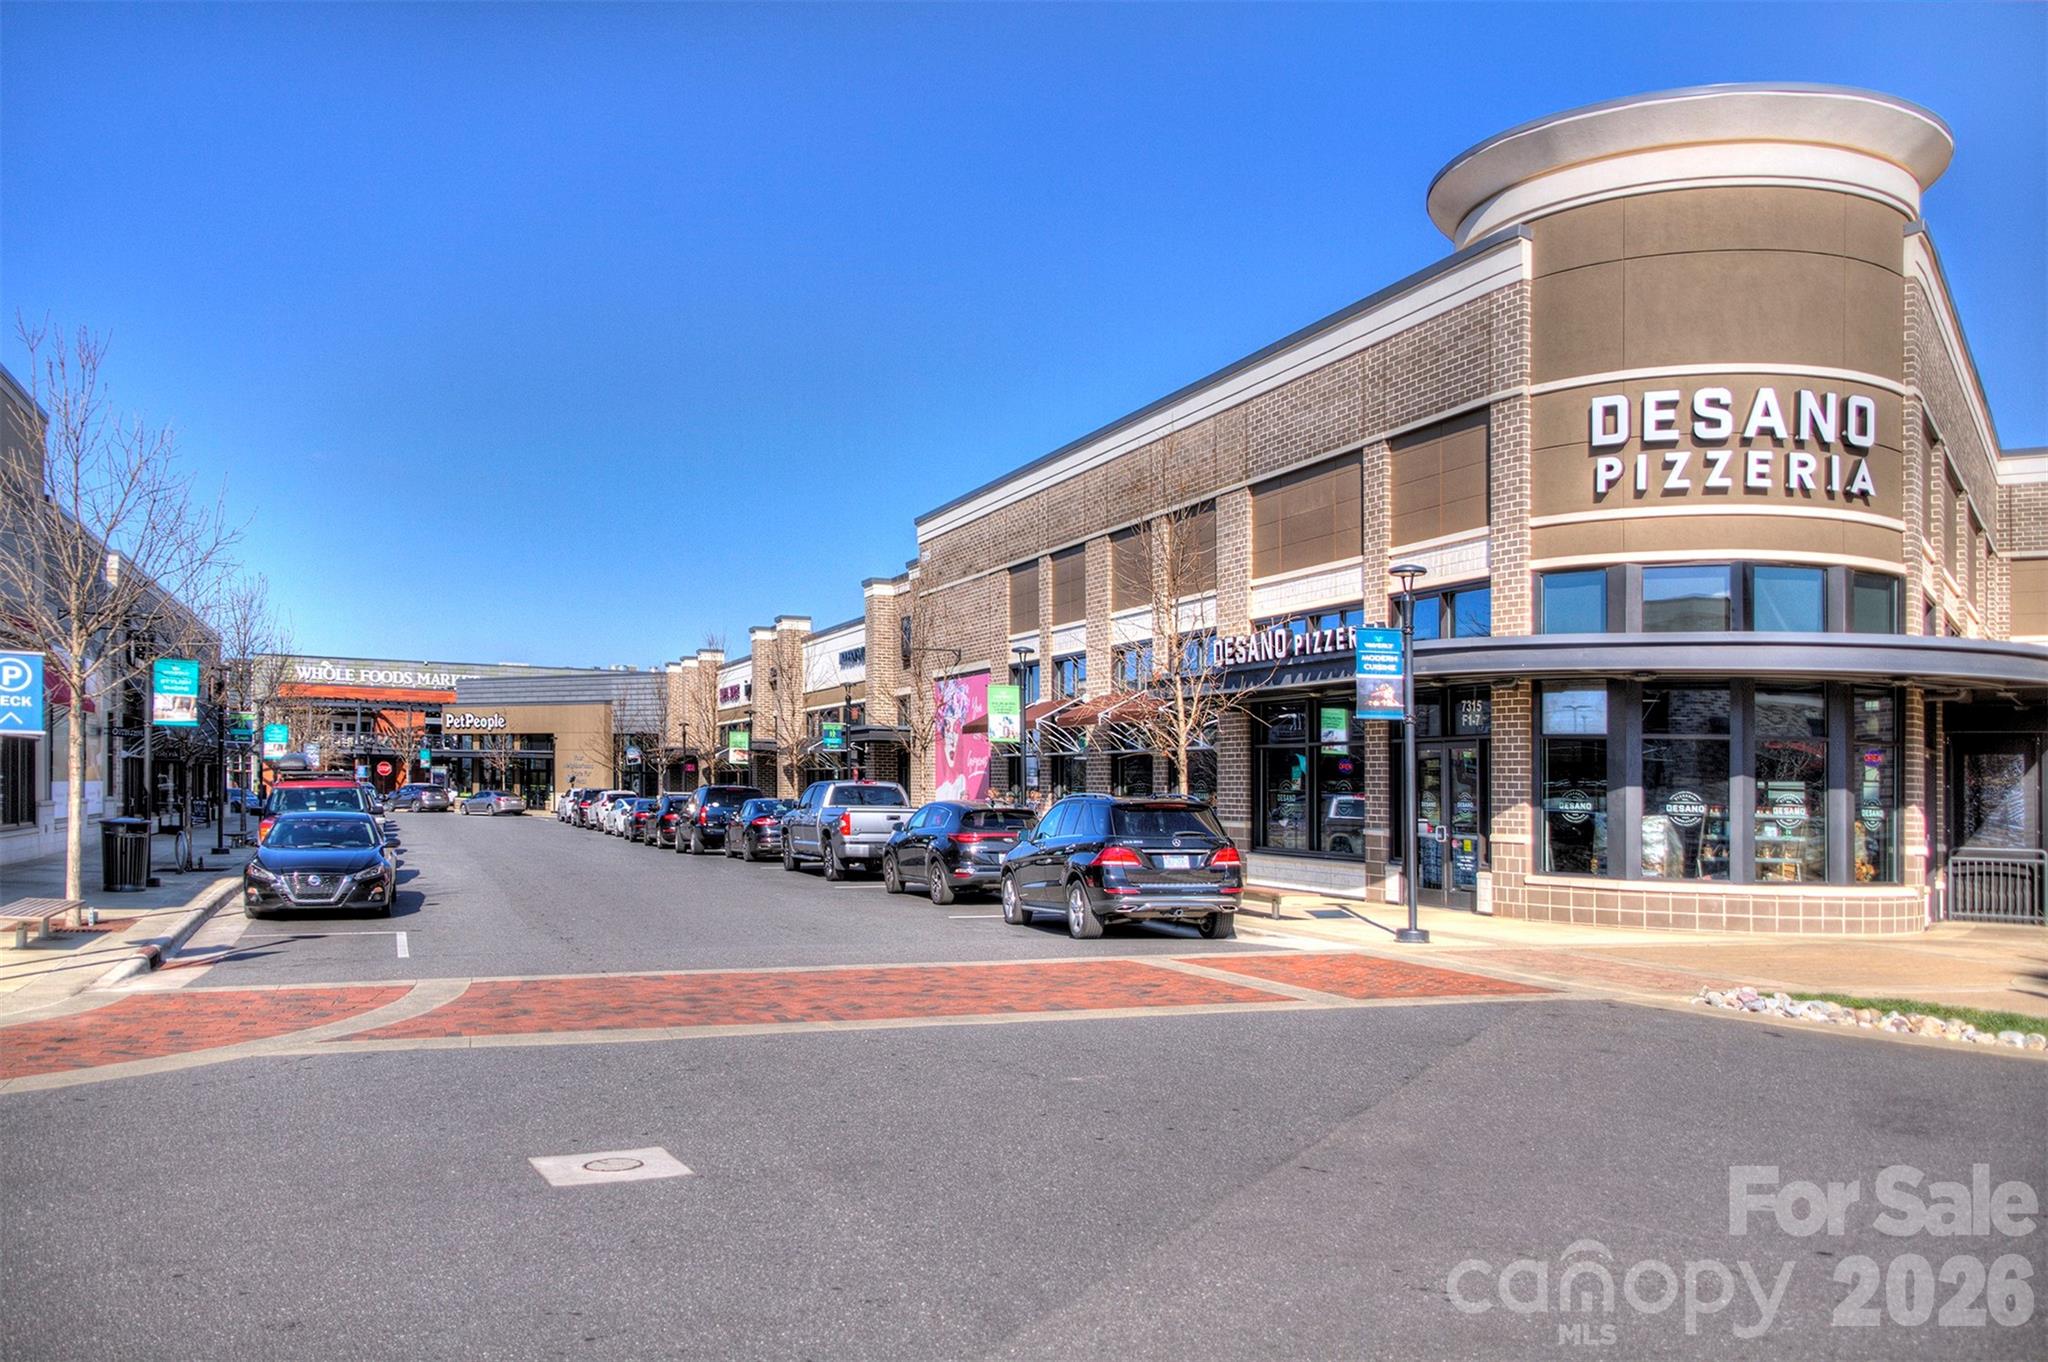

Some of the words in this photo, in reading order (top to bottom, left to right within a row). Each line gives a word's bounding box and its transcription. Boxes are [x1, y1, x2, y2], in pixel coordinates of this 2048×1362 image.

[1591, 386, 1875, 448] DESANO
[1596, 450, 1876, 497] PIZZERIA
[1213, 628, 1287, 666] DESANO
[2, 665, 23, 686] P
[295, 663, 355, 682] WHOLE
[360, 669, 413, 685] FOODS
[417, 672, 479, 686] MARK
[1461, 700, 1482, 713] 7315
[445, 713, 506, 731] PetPeople
[1559, 802, 1592, 810] DESANO
[1666, 804, 1705, 813] DESANO
[1773, 807, 1806, 816] DESANO
[1861, 808, 1885, 818] DESANO
